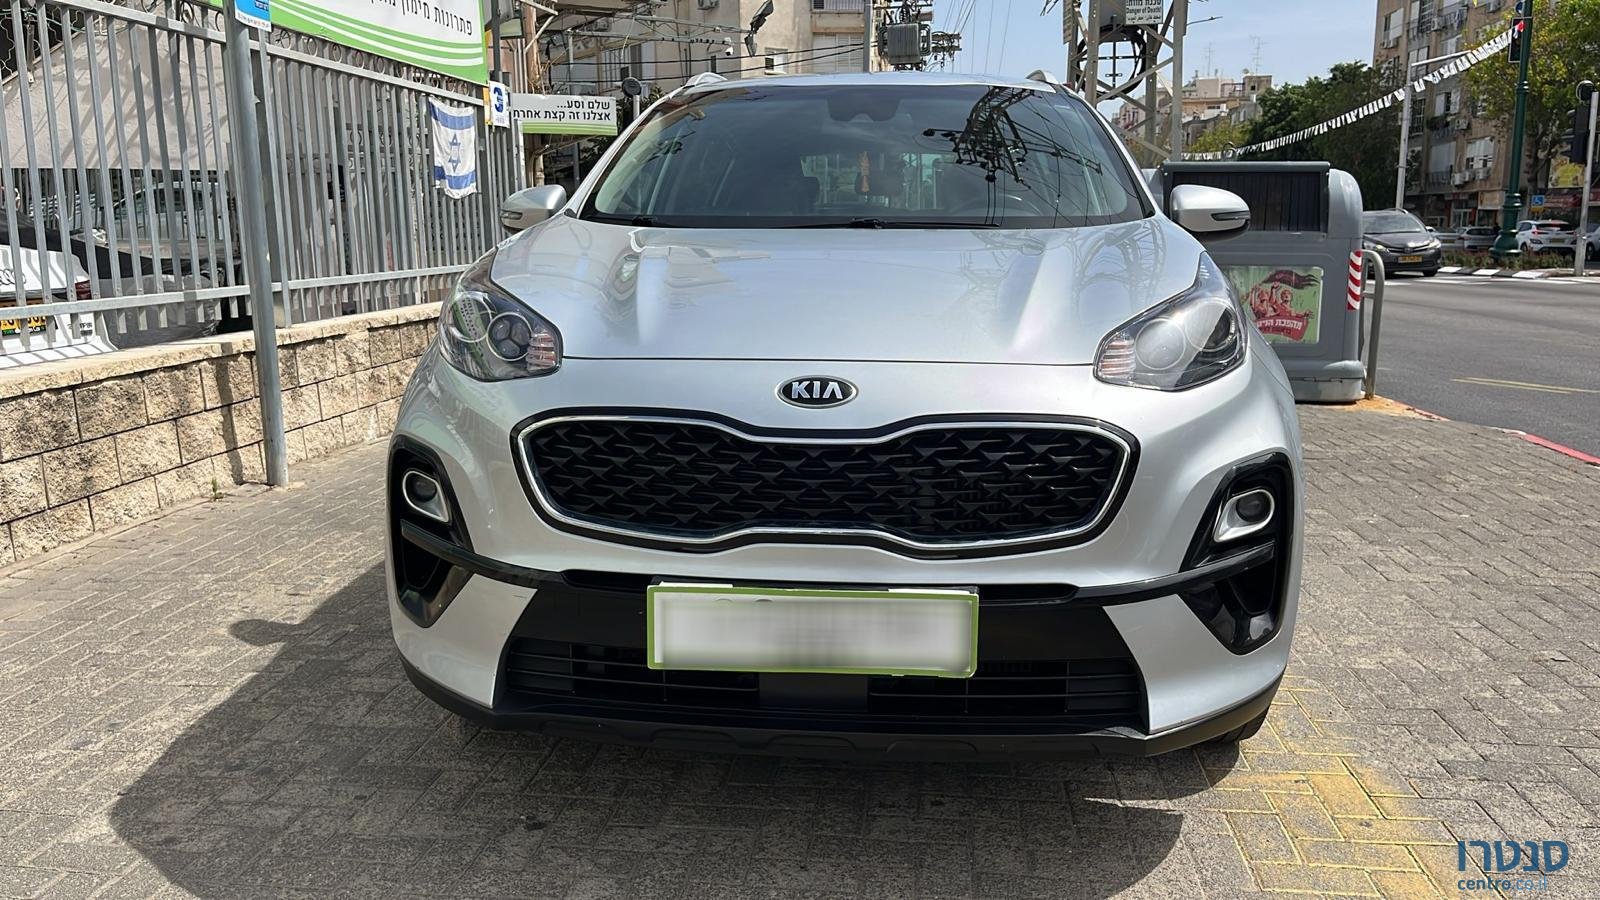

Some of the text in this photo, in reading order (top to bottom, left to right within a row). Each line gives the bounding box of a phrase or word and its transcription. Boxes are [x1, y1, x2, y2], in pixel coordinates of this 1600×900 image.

[1126, 7, 1141, 15] Danger
[401, 0, 472, 36] פתרונות מימון
[556, 100, 610, 109] שלם וסע...
[513, 109, 611, 121] אצלנו זה קצת אחרת
[791, 381, 843, 399] KIA
